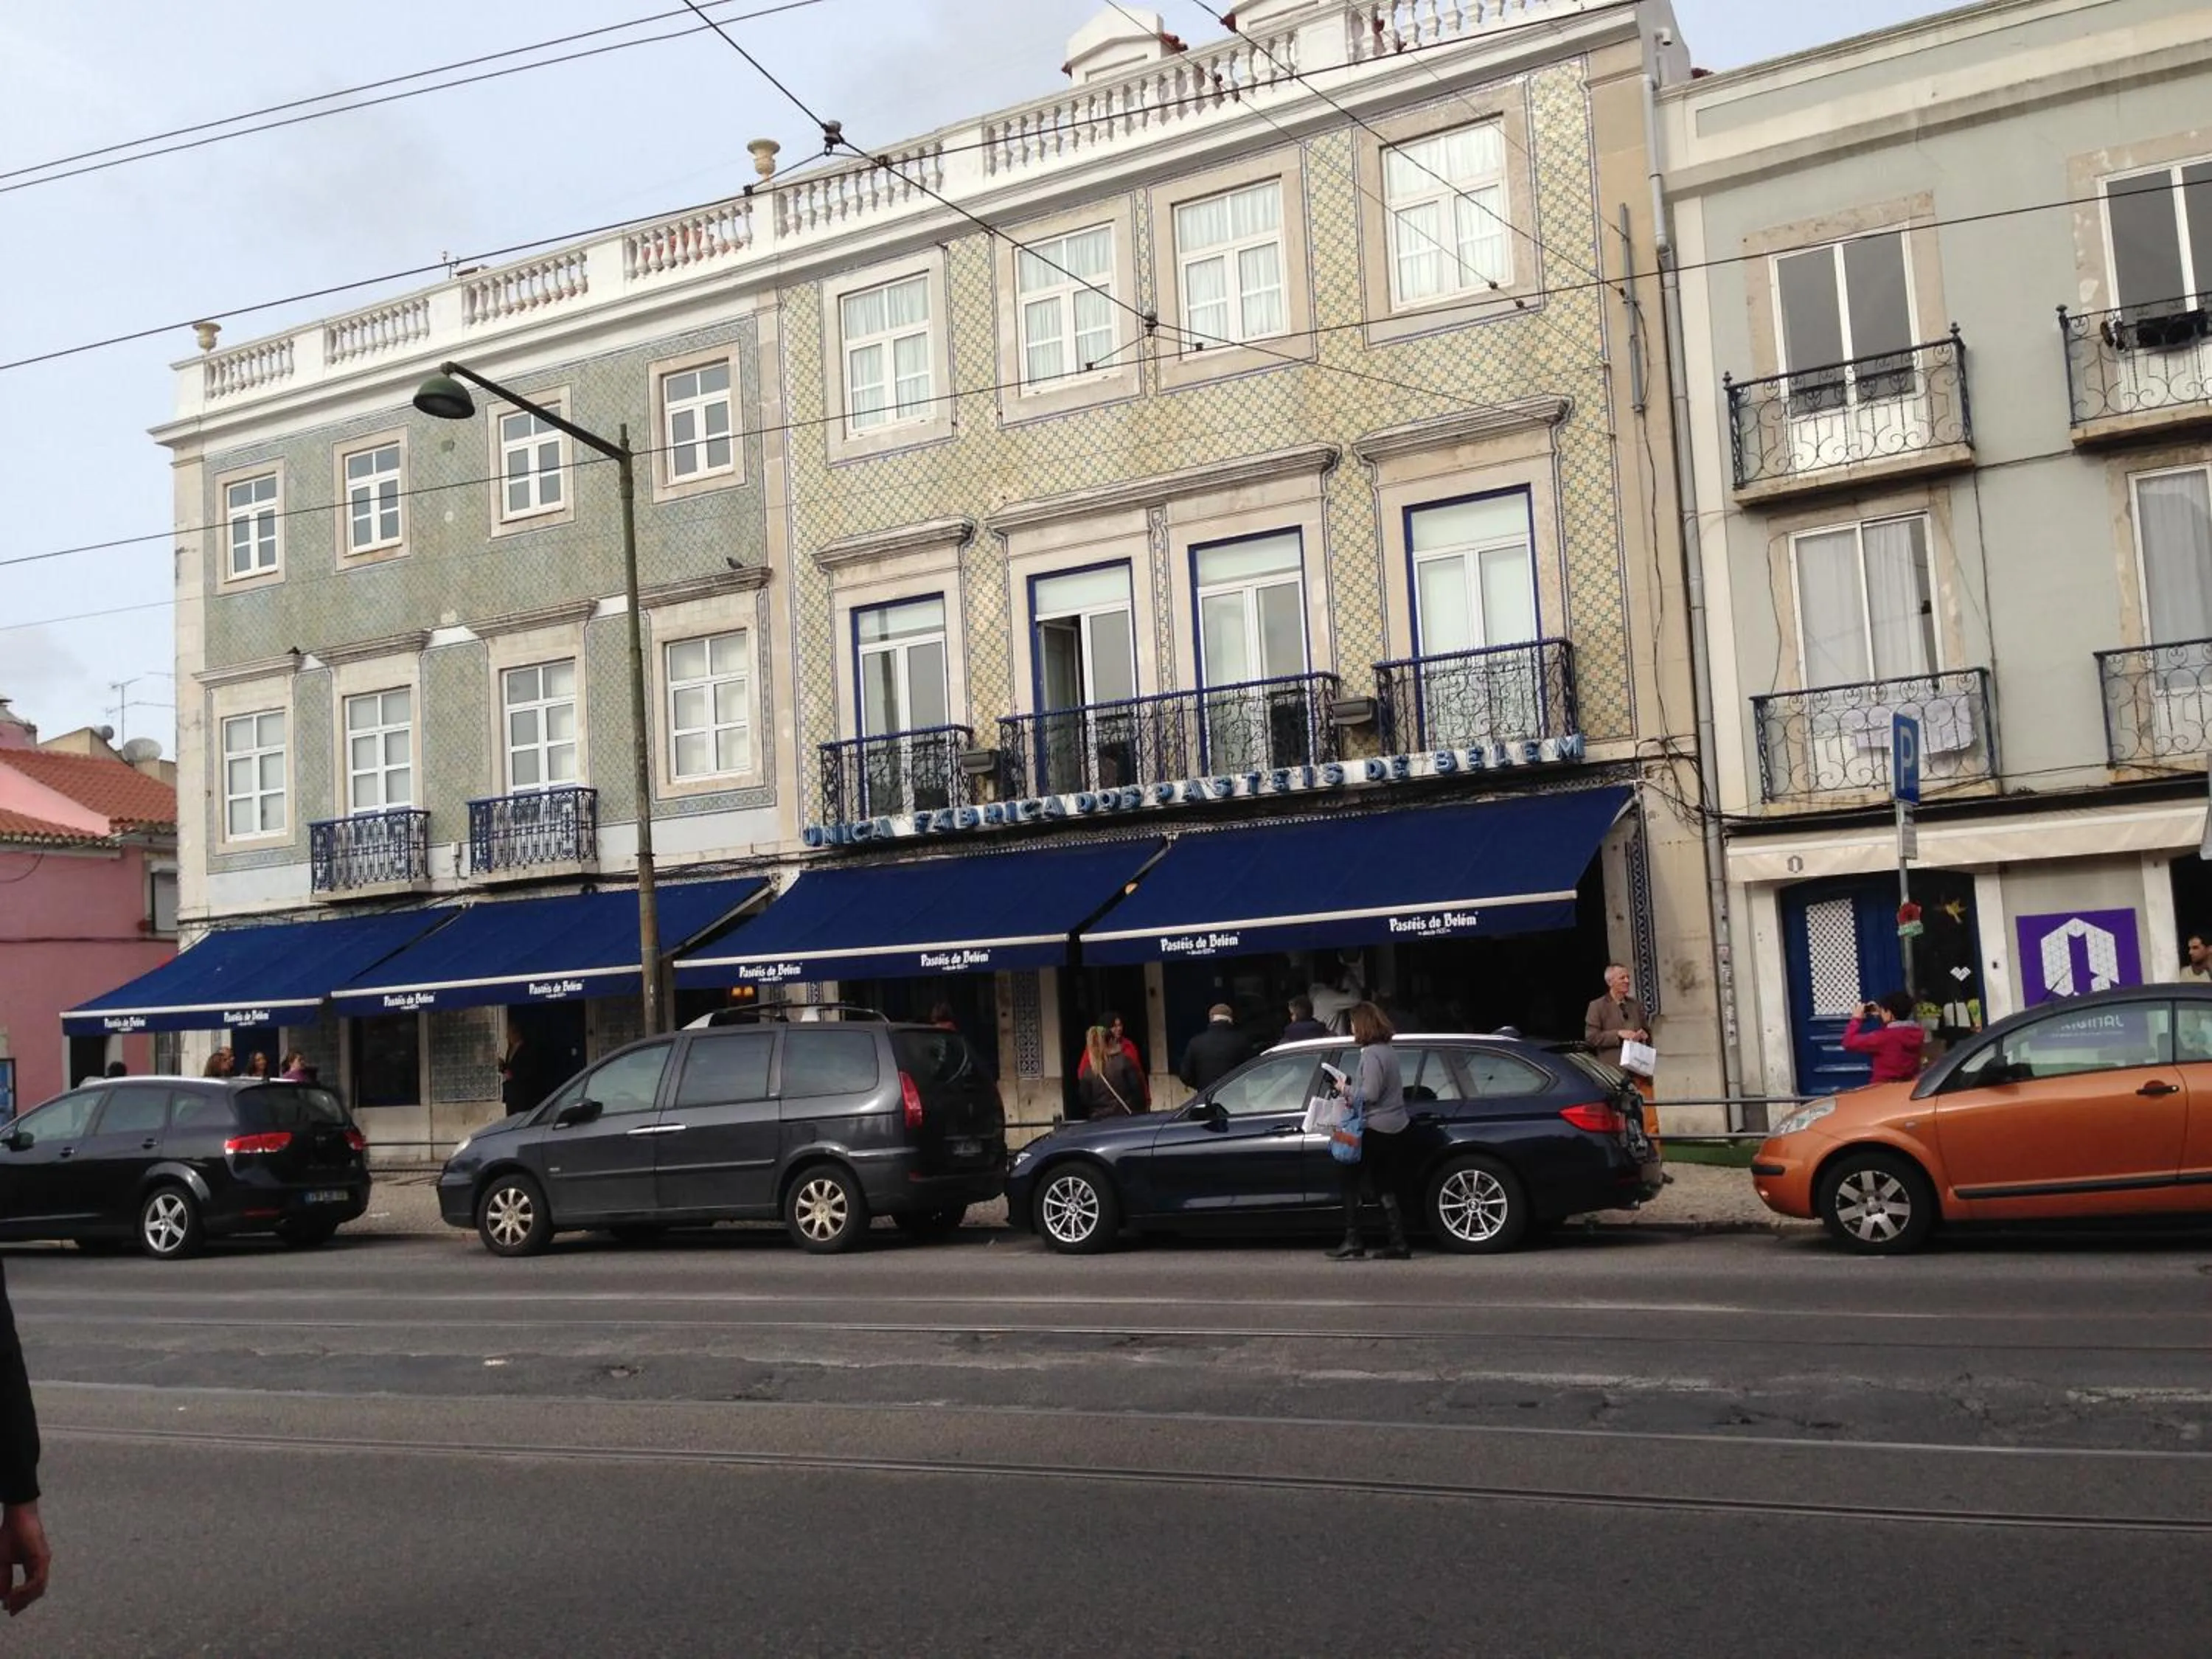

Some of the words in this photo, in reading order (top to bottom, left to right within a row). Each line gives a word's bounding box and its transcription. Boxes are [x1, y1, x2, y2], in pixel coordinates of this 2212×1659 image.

[1899, 725, 1914, 789] P
[1077, 785, 1141, 812] DOS
[1364, 754, 1409, 779] DE
[1389, 916, 1427, 932] Pastéis
[1428, 916, 1441, 928] de
[1443, 912, 1477, 928] Belém
[1195, 936, 1207, 949] de
